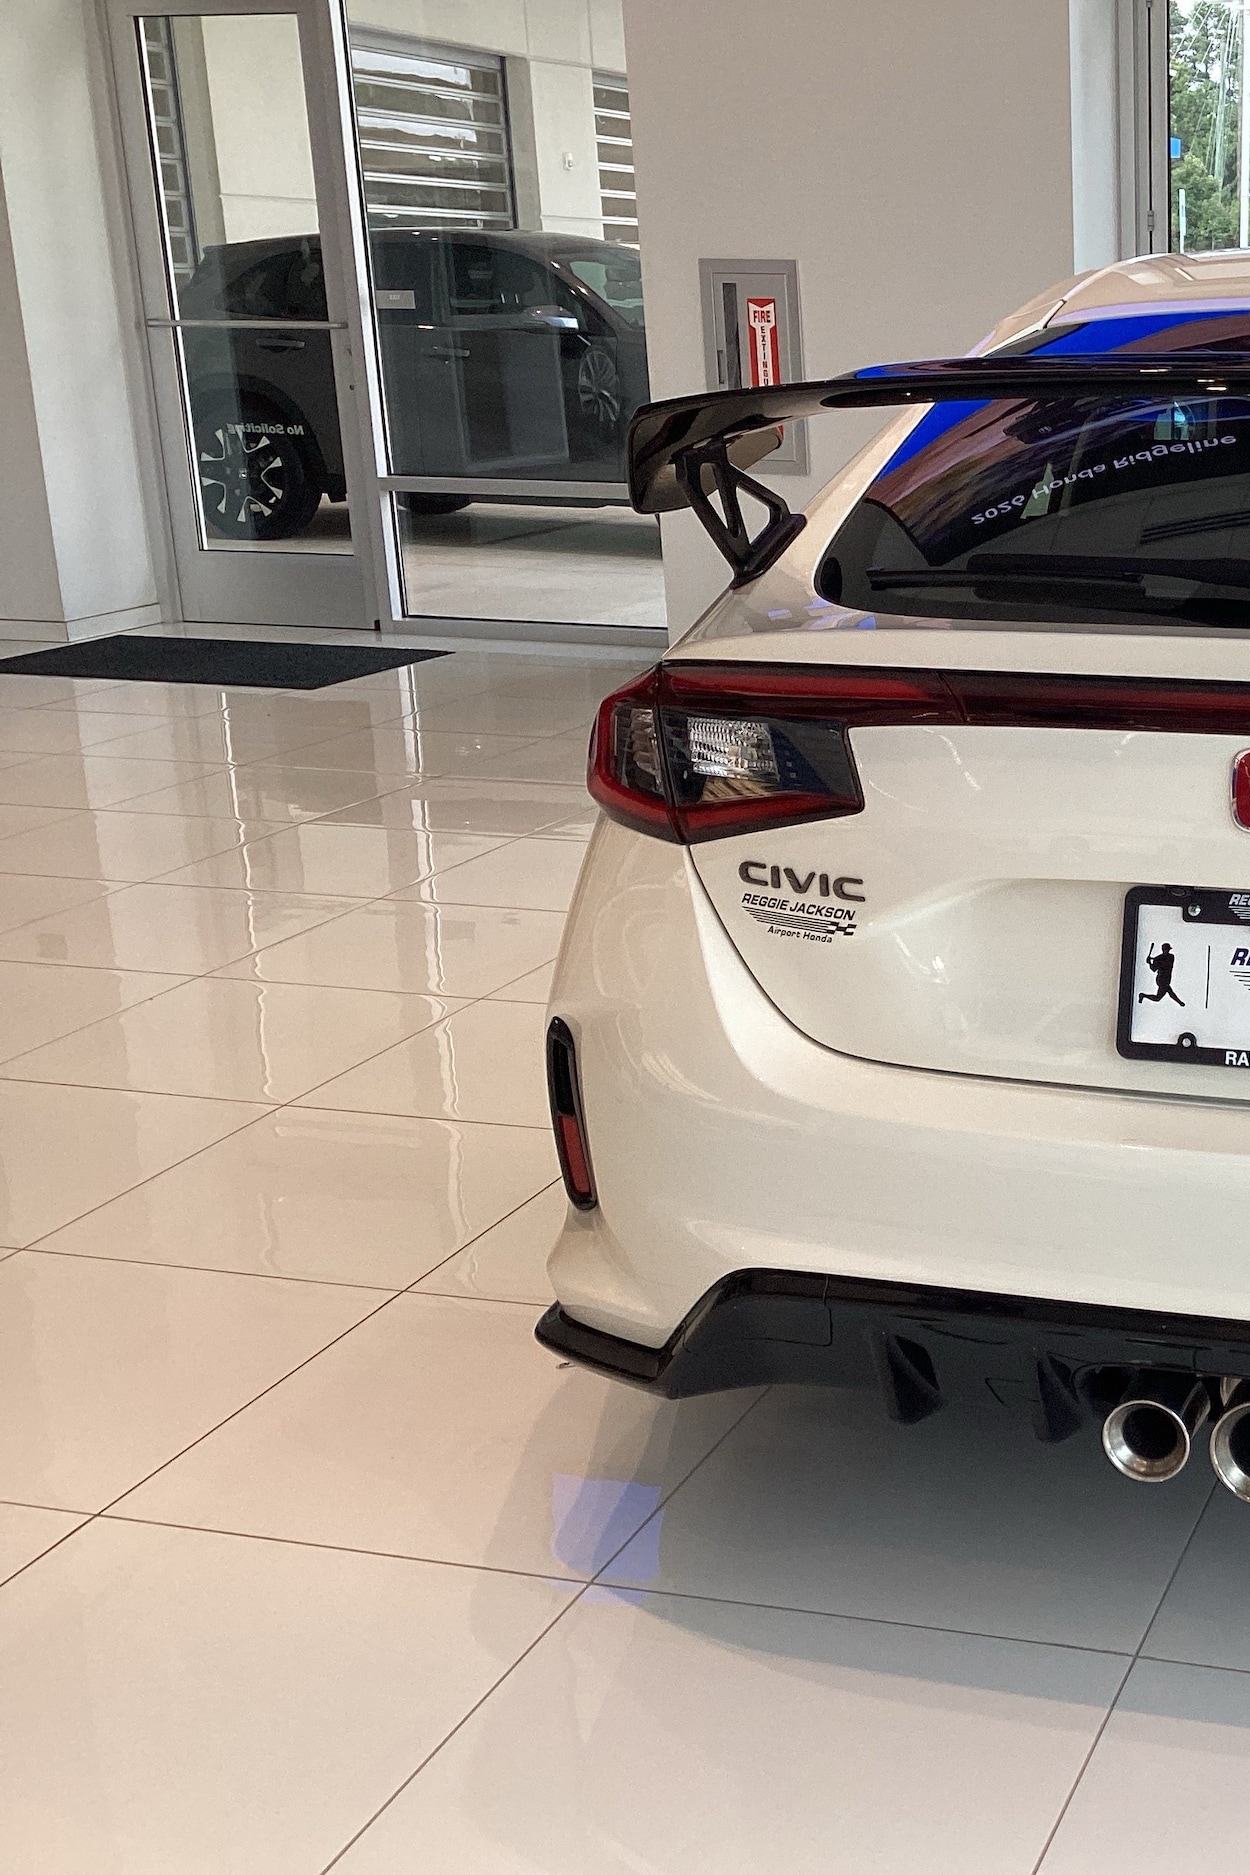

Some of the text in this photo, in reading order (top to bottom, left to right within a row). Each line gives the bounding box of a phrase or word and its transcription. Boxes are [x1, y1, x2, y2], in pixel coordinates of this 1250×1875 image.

[752, 310, 771, 324] FIRE
[760, 325, 770, 387] EXTINGU
[738, 861, 866, 902] CIVIC
[741, 893, 856, 921] REGGIE JACKSON
[767, 926, 833, 944] Airport Honda
